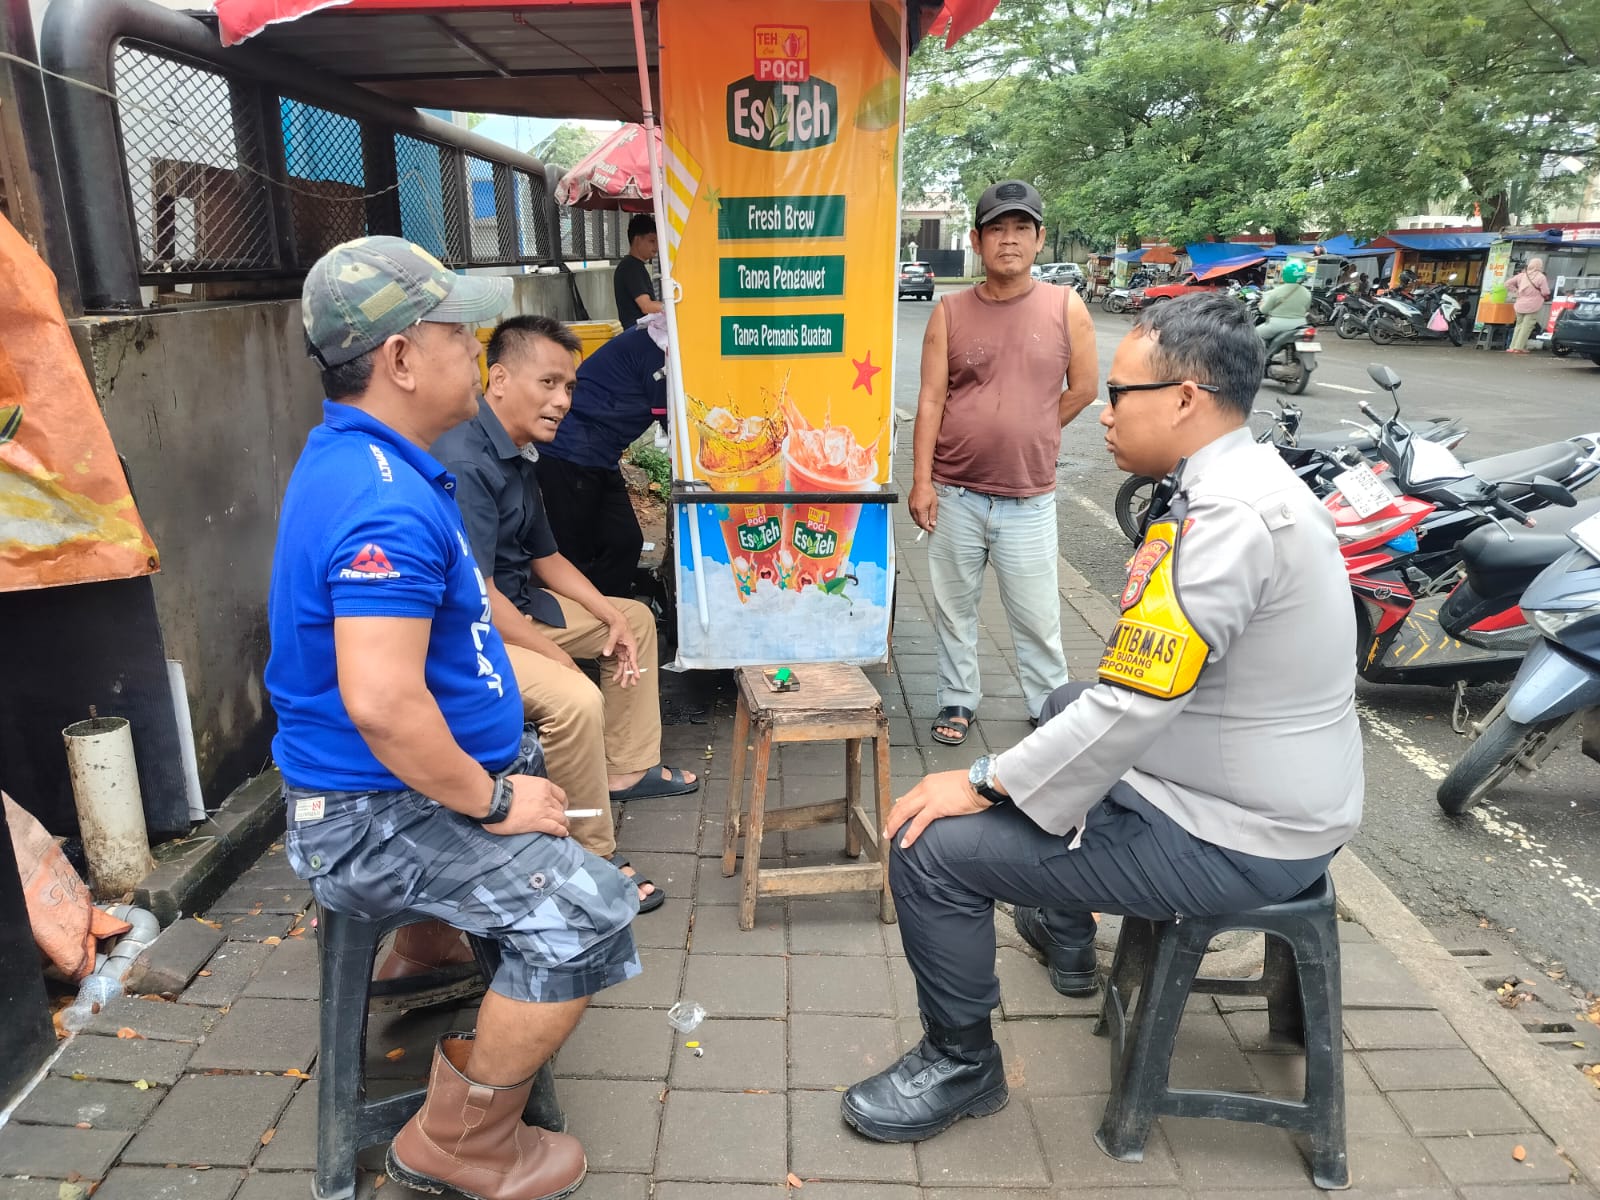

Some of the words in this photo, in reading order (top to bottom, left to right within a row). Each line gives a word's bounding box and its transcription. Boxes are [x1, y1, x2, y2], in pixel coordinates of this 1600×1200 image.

[757, 32, 778, 46] TEH
[760, 60, 804, 79] POCI
[733, 88, 764, 141] Es
[782, 84, 830, 141] Teh
[748, 204, 782, 230] Fresh
[784, 205, 816, 230] Brew
[737, 265, 770, 289] Tanpa
[773, 265, 826, 290] Pengawet
[732, 323, 759, 346] Tanpa
[761, 324, 799, 347] Pemanis
[801, 324, 832, 346] Buatan
[747, 514, 767, 526] POCI
[807, 520, 827, 532] POCI
[739, 530, 755, 547] Es
[758, 521, 780, 546] Teh
[794, 527, 808, 550] Es
[815, 532, 836, 554] Teh
[1116, 651, 1152, 669] GUDANG
